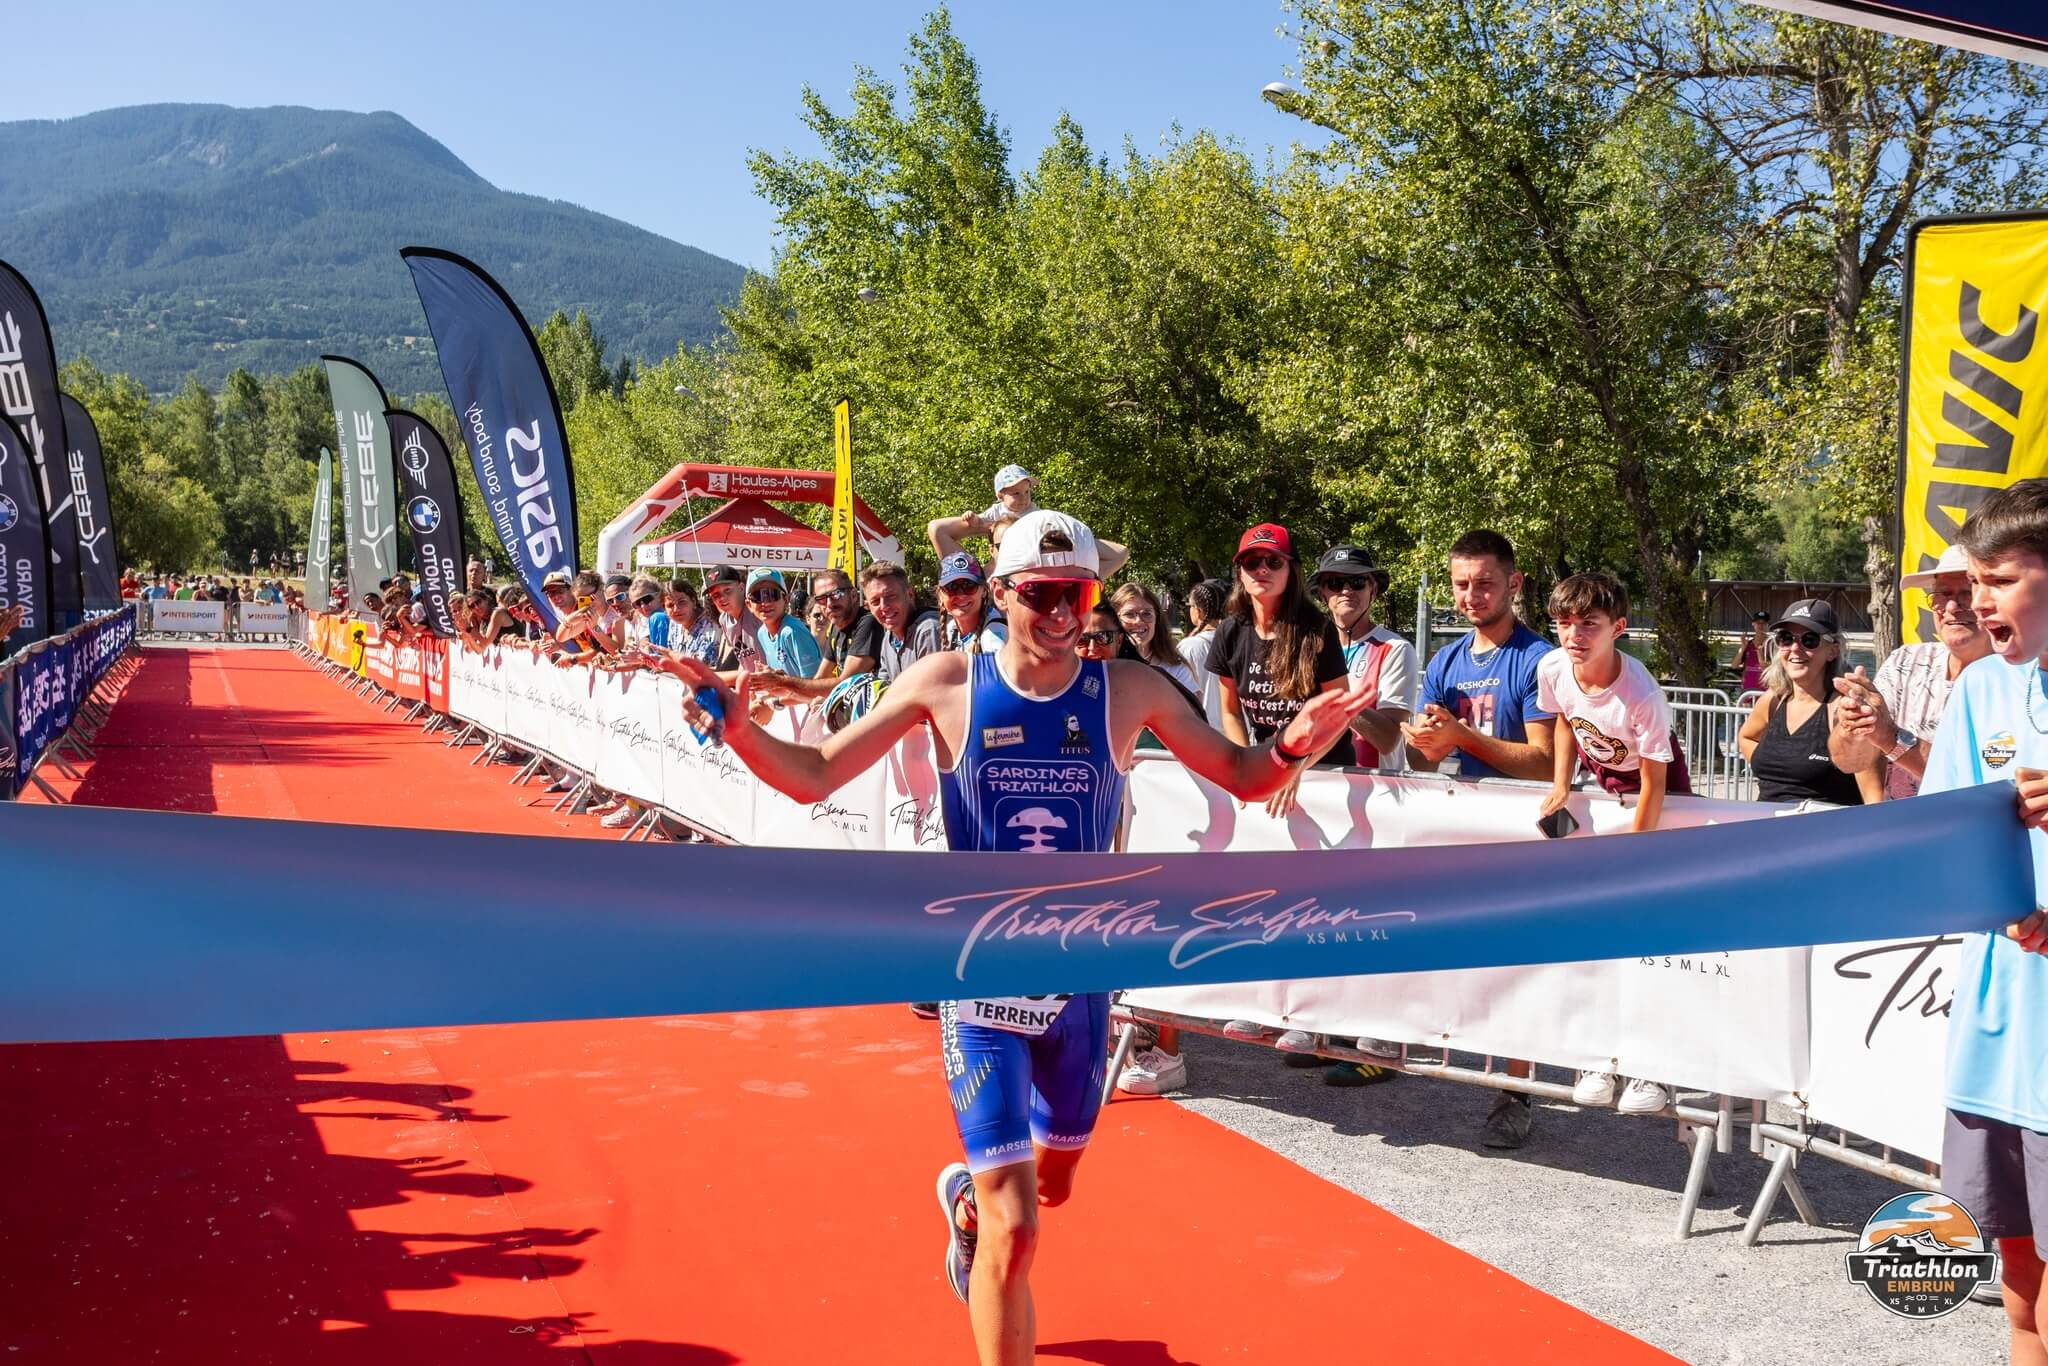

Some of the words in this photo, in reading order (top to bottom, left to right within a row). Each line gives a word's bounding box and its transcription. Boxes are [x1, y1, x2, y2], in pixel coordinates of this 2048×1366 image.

[1915, 280, 2038, 642] AVIC
[731, 472, 818, 491] Hautes-Alpes
[740, 549, 762, 560] ON
[766, 550, 792, 560] EST
[795, 548, 814, 561] LÀ
[168, 611, 217, 619] INTERSPORT
[1248, 662, 1262, 675] Je
[1248, 680, 1274, 694] Peti
[1060, 746, 1091, 755] TITUS
[987, 767, 1089, 780] SARDINES
[987, 781, 1089, 793] TRIATHLON
[859, 824, 869, 833] XL
[924, 864, 1179, 982] Triathlon
[1306, 931, 1326, 945] XS
[1335, 931, 1348, 943] M
[1356, 930, 1363, 942] L
[1371, 928, 1389, 941] XL
[1663, 956, 1672, 968] S
[1680, 959, 1692, 971] M
[1700, 961, 1707, 974] L
[1715, 963, 1730, 978] XL
[945, 1000, 964, 1075] ARDINES
[1047, 1132, 1089, 1143] MARSE
[985, 1140, 1034, 1158] MARSEIL
